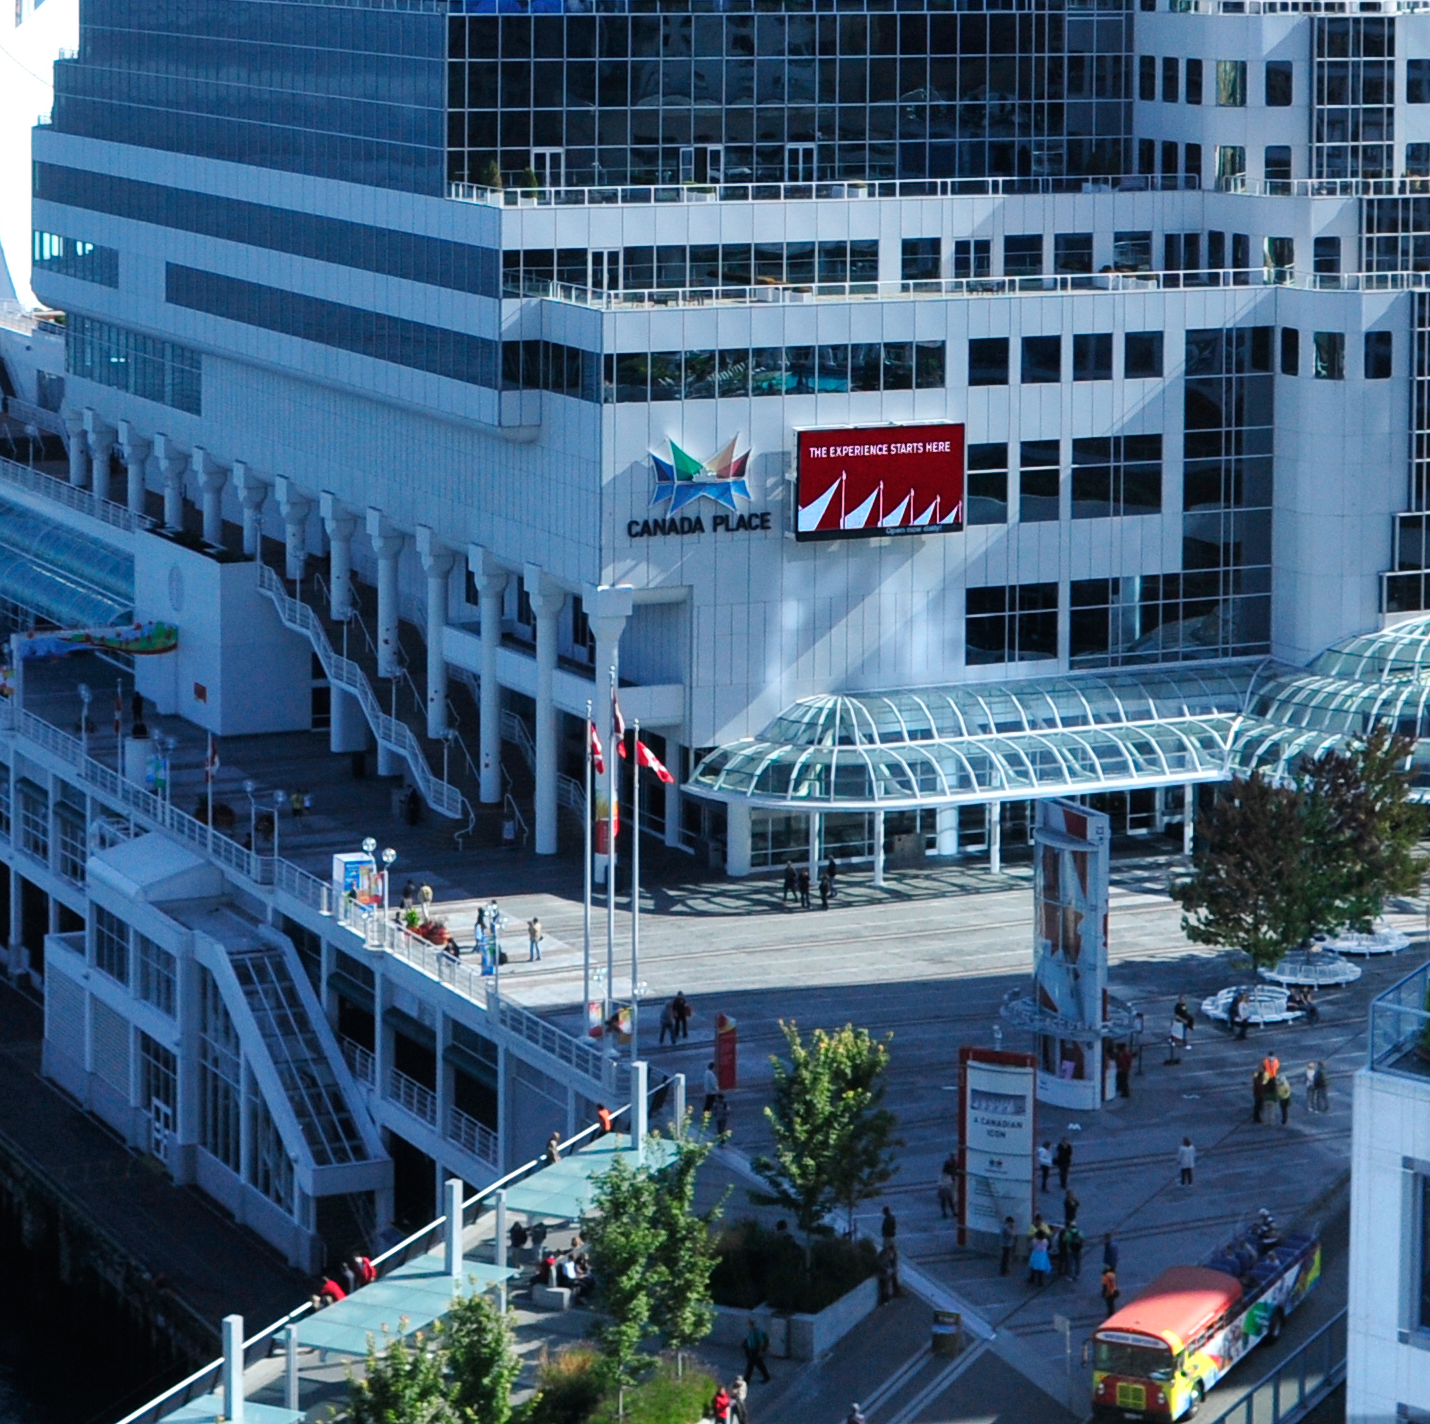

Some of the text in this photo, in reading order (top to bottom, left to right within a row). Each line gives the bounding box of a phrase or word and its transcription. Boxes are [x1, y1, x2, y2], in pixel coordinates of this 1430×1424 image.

[809, 441, 951, 458] THE EXPERIENCE STARTS HERE
[627, 512, 772, 538] CANADA PLACE
[885, 527, 906, 535] Open
[980, 1116, 1023, 1128] CANADIAN
